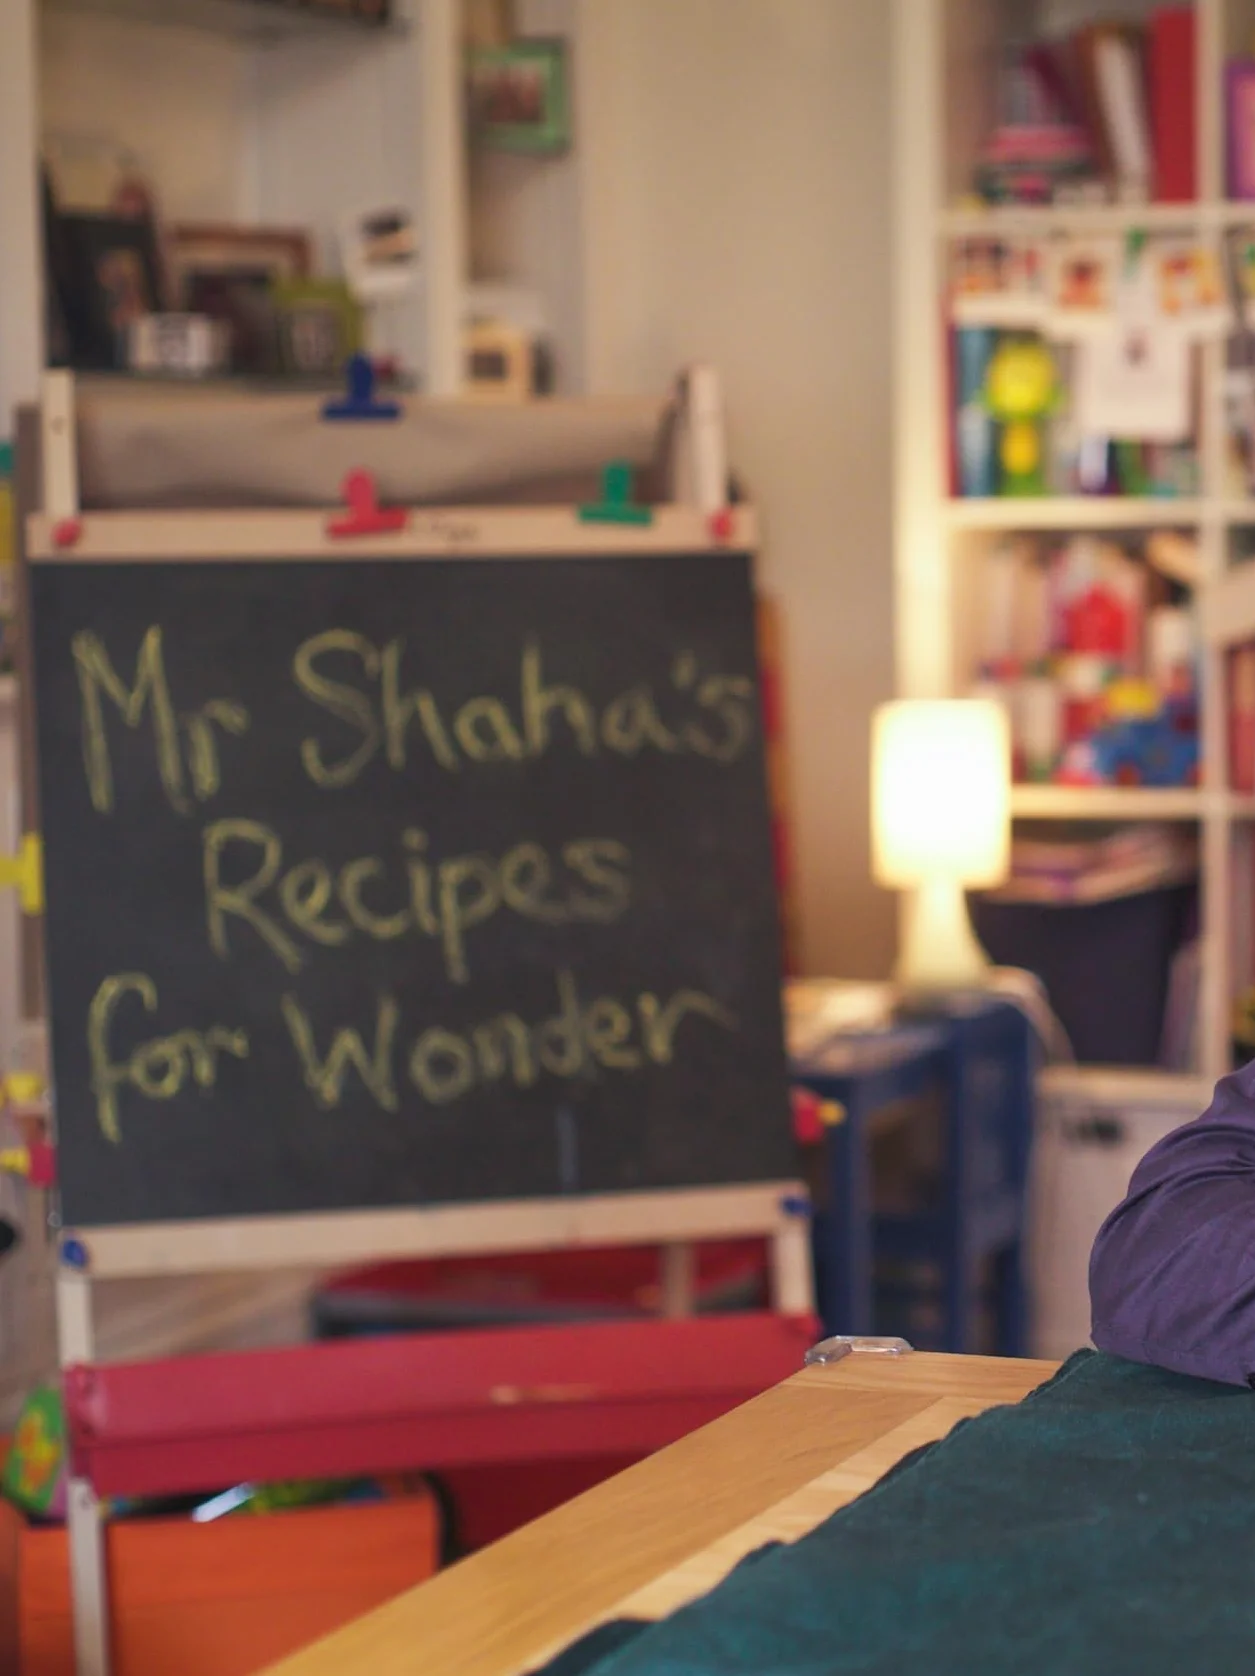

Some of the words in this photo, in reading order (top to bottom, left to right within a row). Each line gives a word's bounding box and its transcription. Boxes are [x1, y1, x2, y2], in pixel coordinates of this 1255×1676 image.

[72, 624, 250, 813] Mr
[292, 627, 755, 788] Shaha's
[202, 816, 632, 984] Recipes
[87, 970, 250, 1145] for
[281, 967, 739, 1112] Wonder
